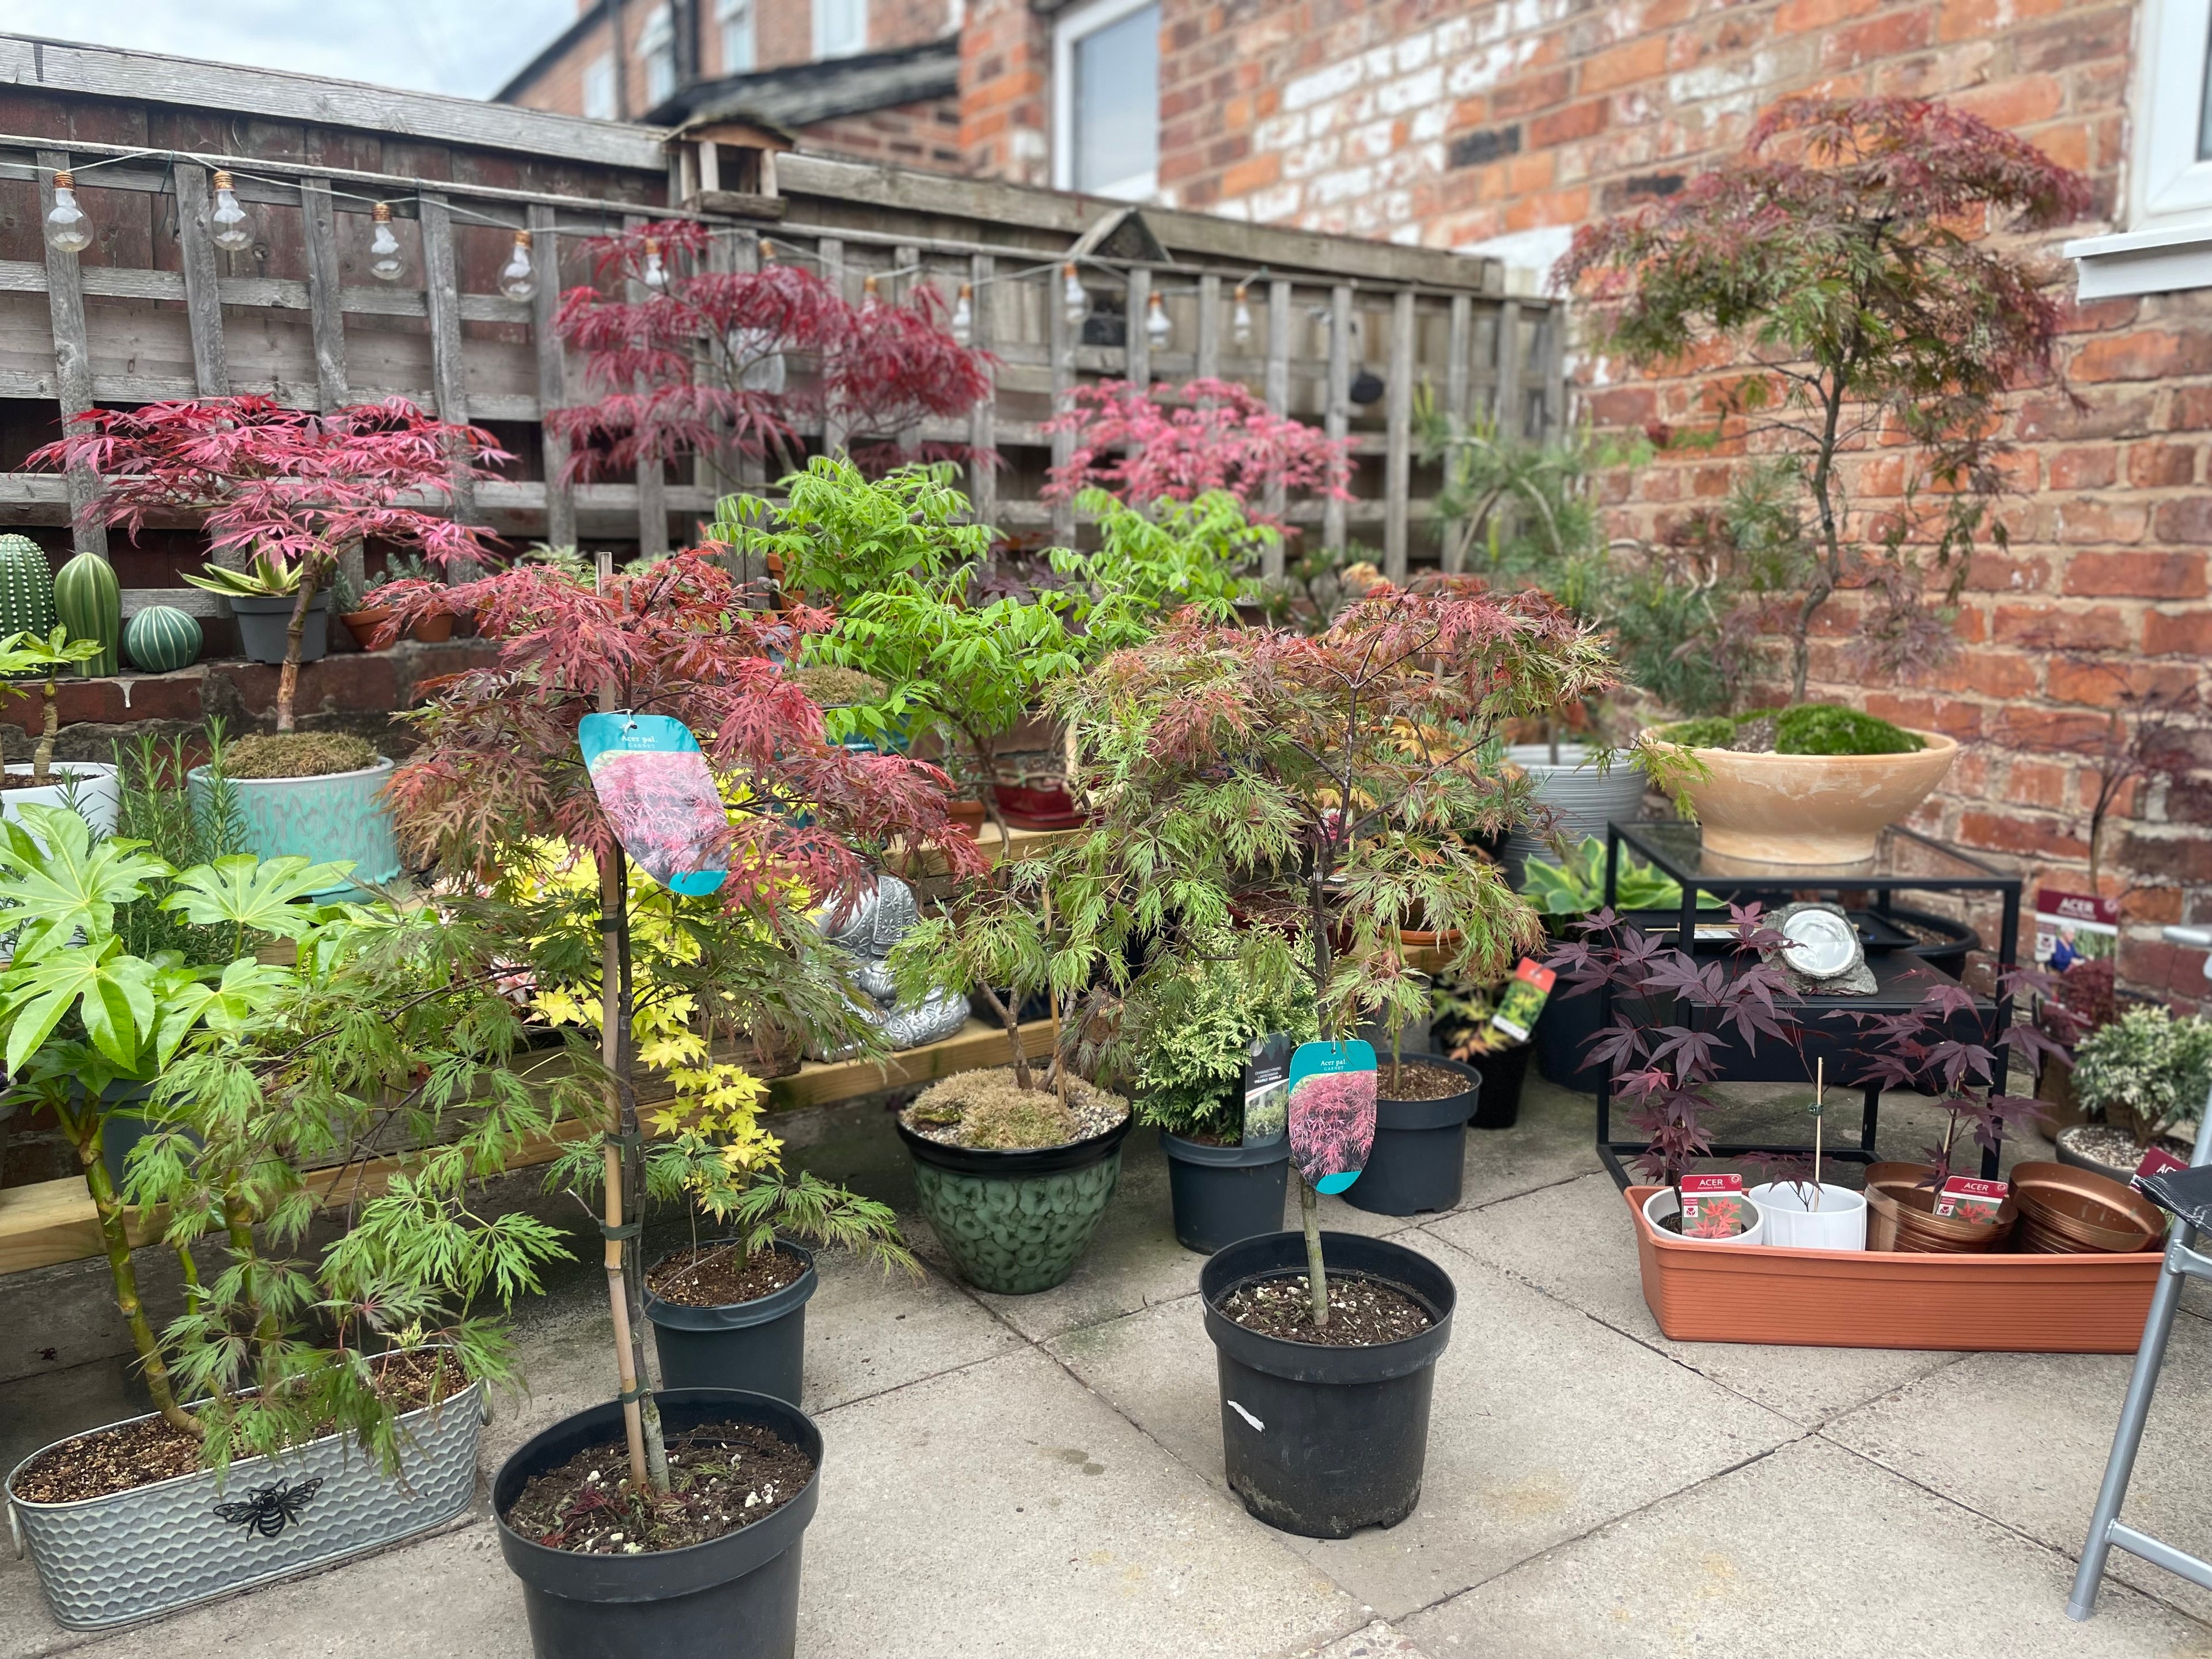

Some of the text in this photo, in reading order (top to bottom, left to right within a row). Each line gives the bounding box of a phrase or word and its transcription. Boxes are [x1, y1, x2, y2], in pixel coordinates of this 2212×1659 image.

[641, 736, 658, 744] pal.
[2058, 897, 2095, 914] ACER
[1336, 1058, 1347, 1067] pal.
[1964, 1182, 1989, 1192] ACER
